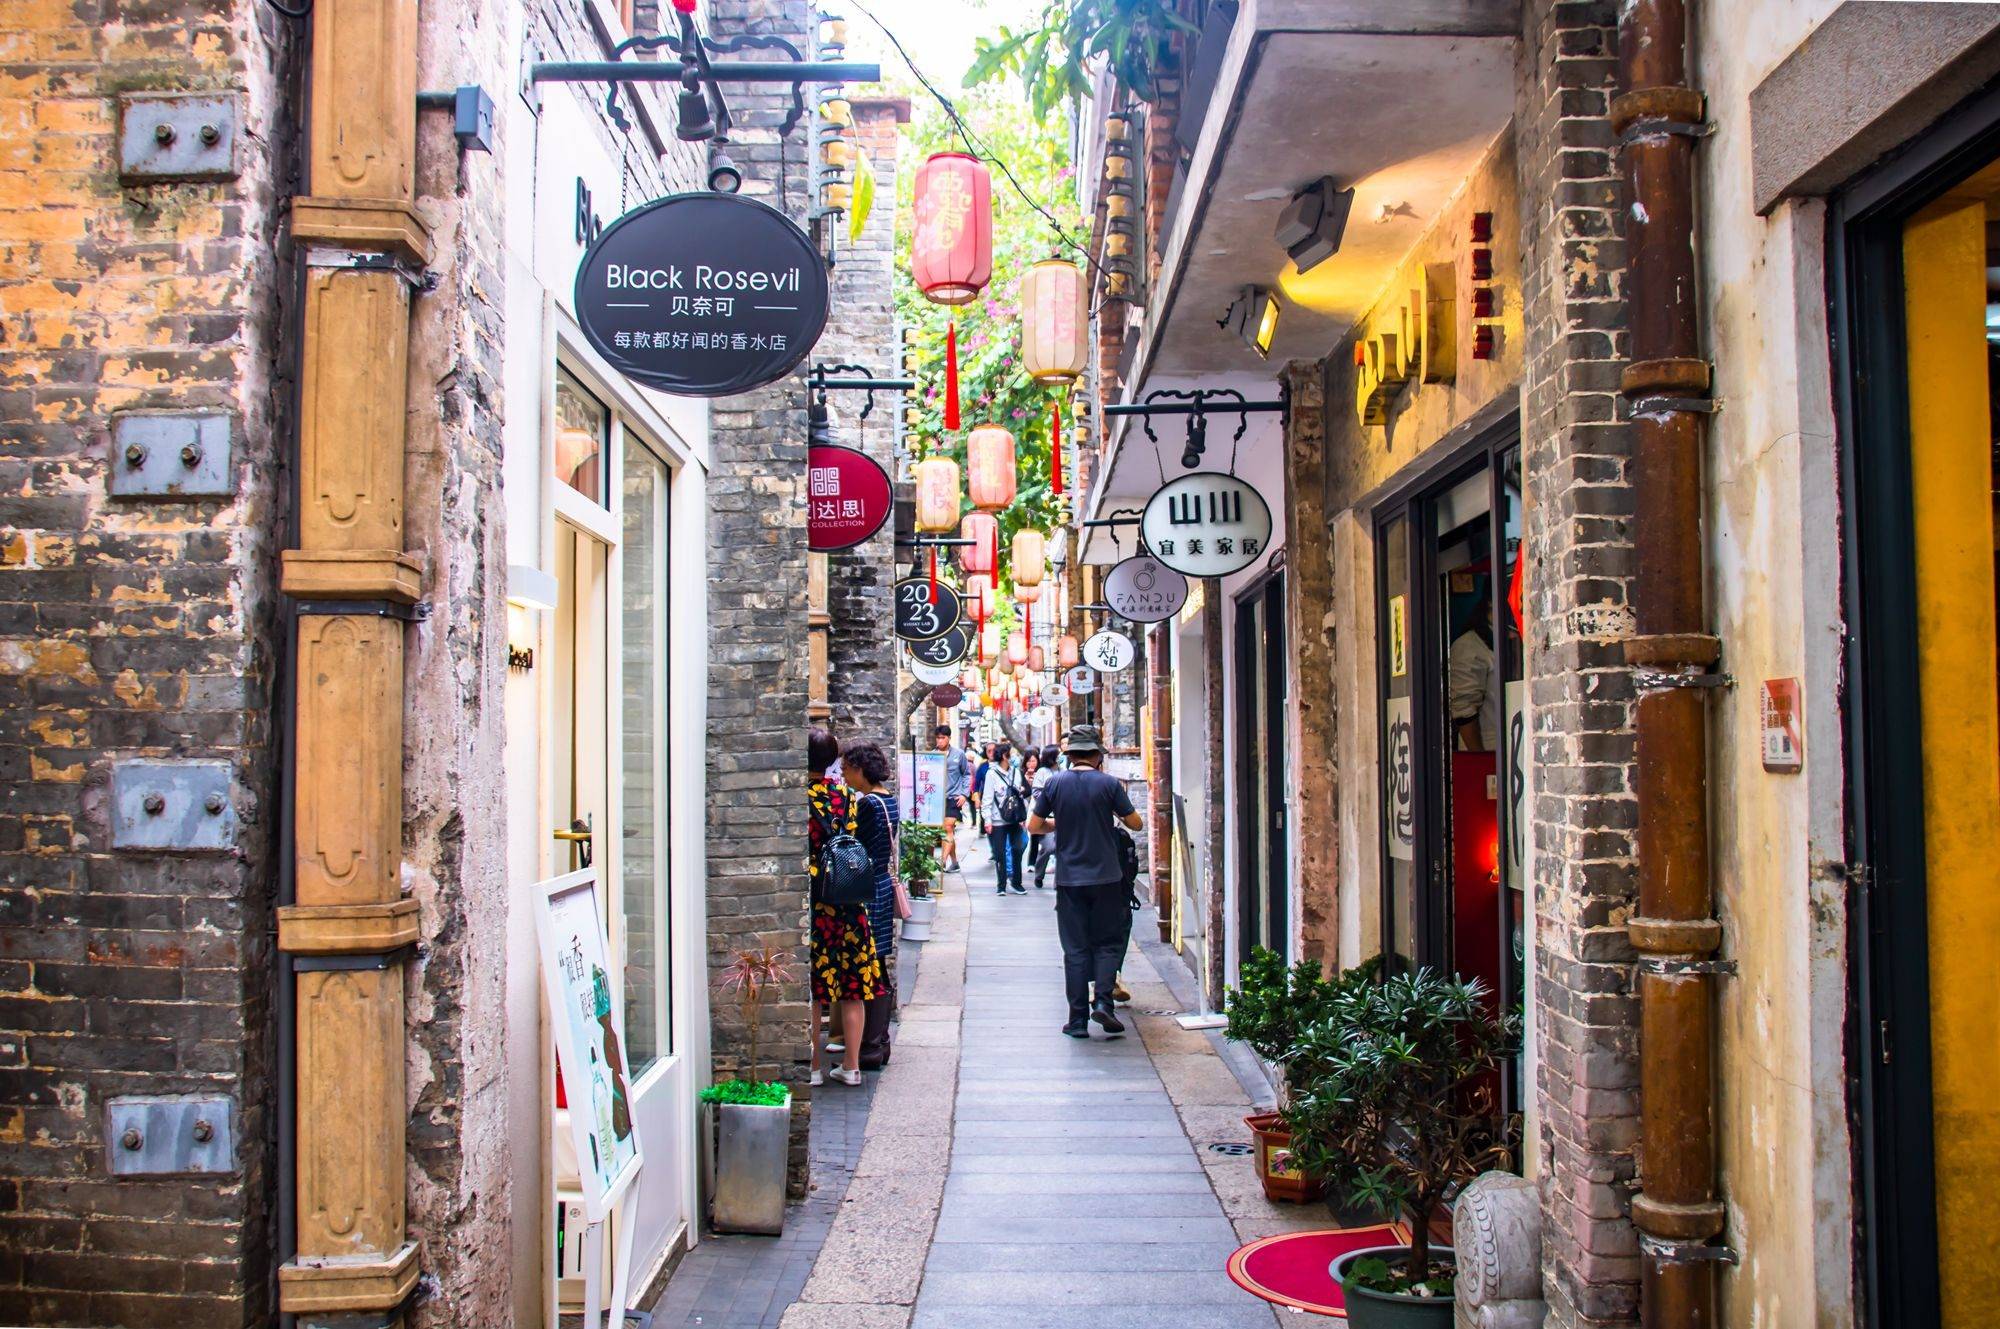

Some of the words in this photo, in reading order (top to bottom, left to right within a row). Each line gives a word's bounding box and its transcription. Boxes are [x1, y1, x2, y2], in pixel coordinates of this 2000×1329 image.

[607, 264, 683, 289] Black
[695, 265, 800, 292] Rosevil
[670, 296, 735, 317] 贝奈可
[614, 330, 787, 351] 每款都好闻的香水店
[808, 499, 860, 519] 达思
[1169, 490, 1242, 525] 山川
[811, 520, 865, 528] COLLECTION
[1159, 537, 1258, 555] 宜美家居
[902, 584, 930, 602] 20
[1117, 593, 1174, 604] FANDU
[910, 603, 939, 635] 23
